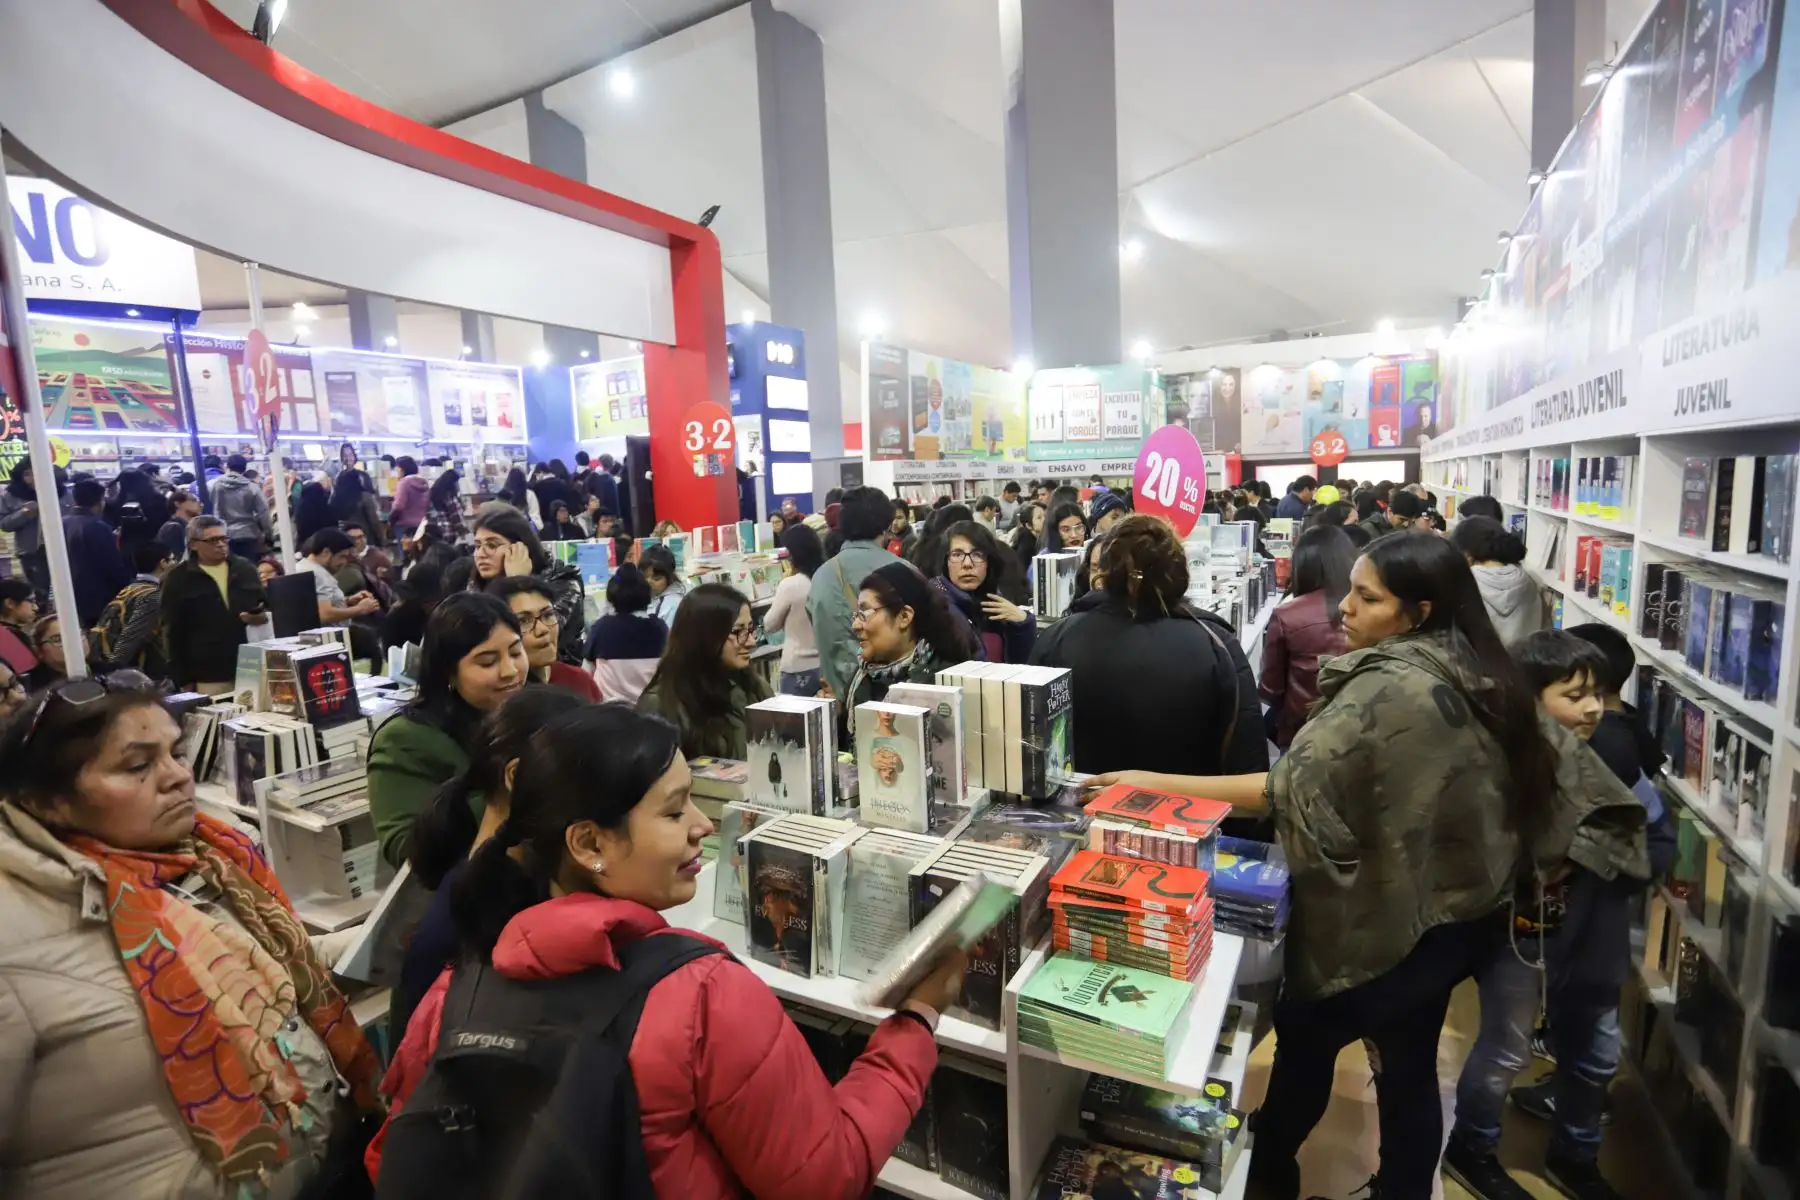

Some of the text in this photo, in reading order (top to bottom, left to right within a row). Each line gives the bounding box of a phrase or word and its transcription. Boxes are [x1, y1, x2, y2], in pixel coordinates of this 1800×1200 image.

[1662, 308, 1760, 367] LITERATURA
[1531, 369, 1627, 429] LITERATURA JUVENIL
[1674, 378, 1731, 416] JUVENIL
[1048, 464, 1086, 472] ENSAYO
[1047, 689, 1071, 714] POTTER
[1050, 678, 1069, 698] HARRY
[1062, 963, 1115, 1005] QUIDDITCH
[457, 1032, 516, 1049] Targus
[1156, 1168, 1172, 1199] Rowling
